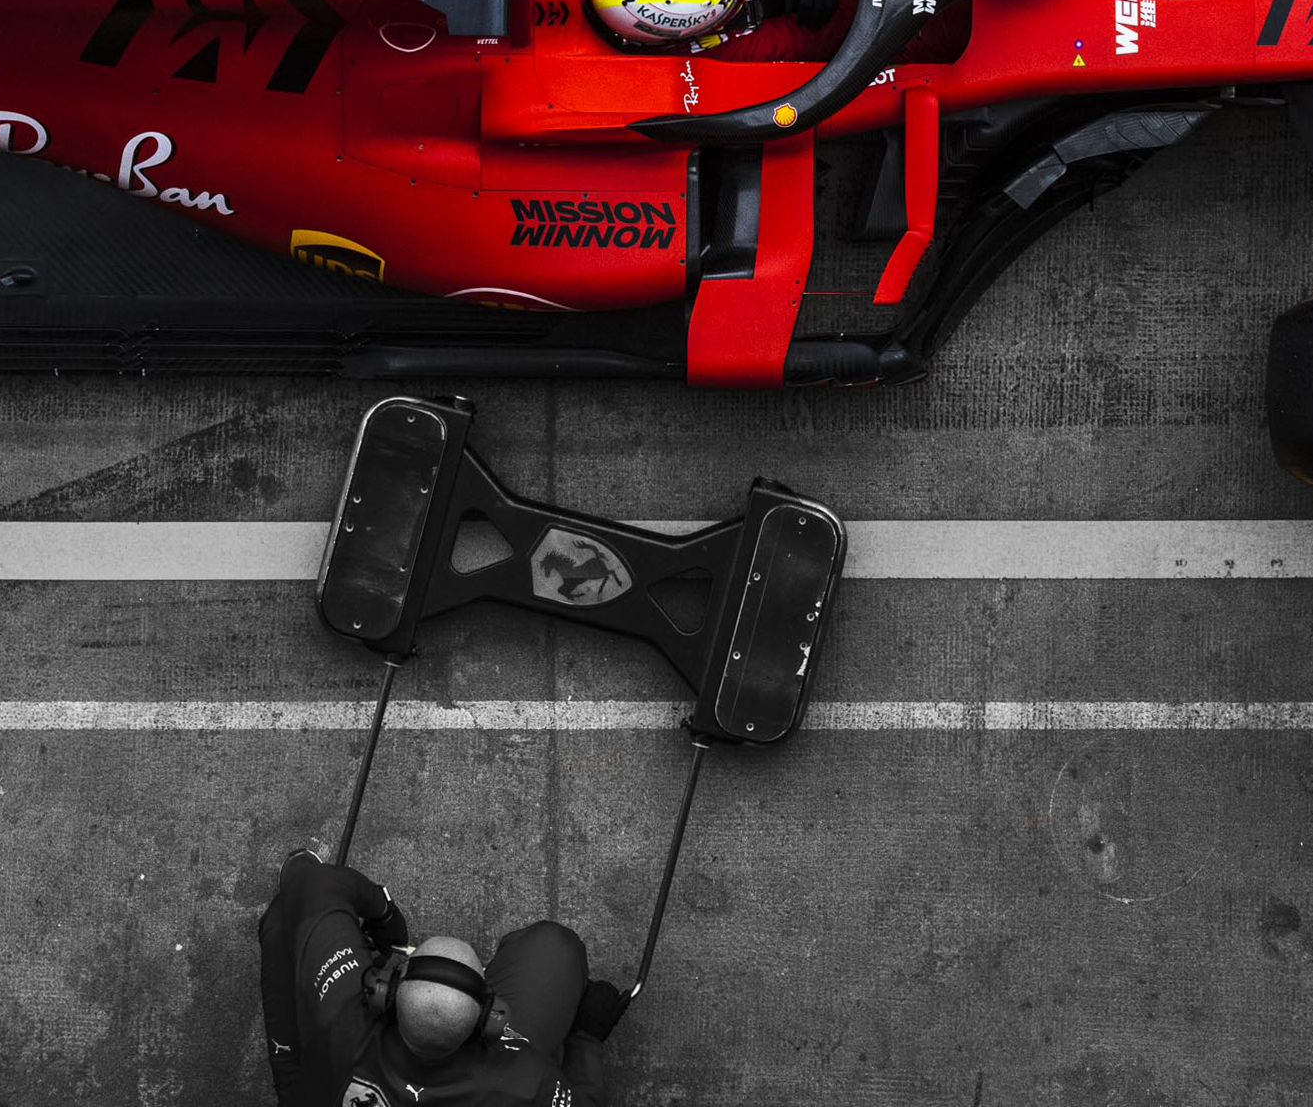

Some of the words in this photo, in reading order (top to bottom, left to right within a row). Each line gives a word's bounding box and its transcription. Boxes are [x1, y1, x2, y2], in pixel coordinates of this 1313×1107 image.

[637, 5, 710, 28] KASPERSKY
[680, 60, 699, 113] Ray-Ban
[510, 199, 676, 225] MISSION
[509, 224, 676, 249] WINNOW
[319, 959, 359, 1001] HUBLOT
